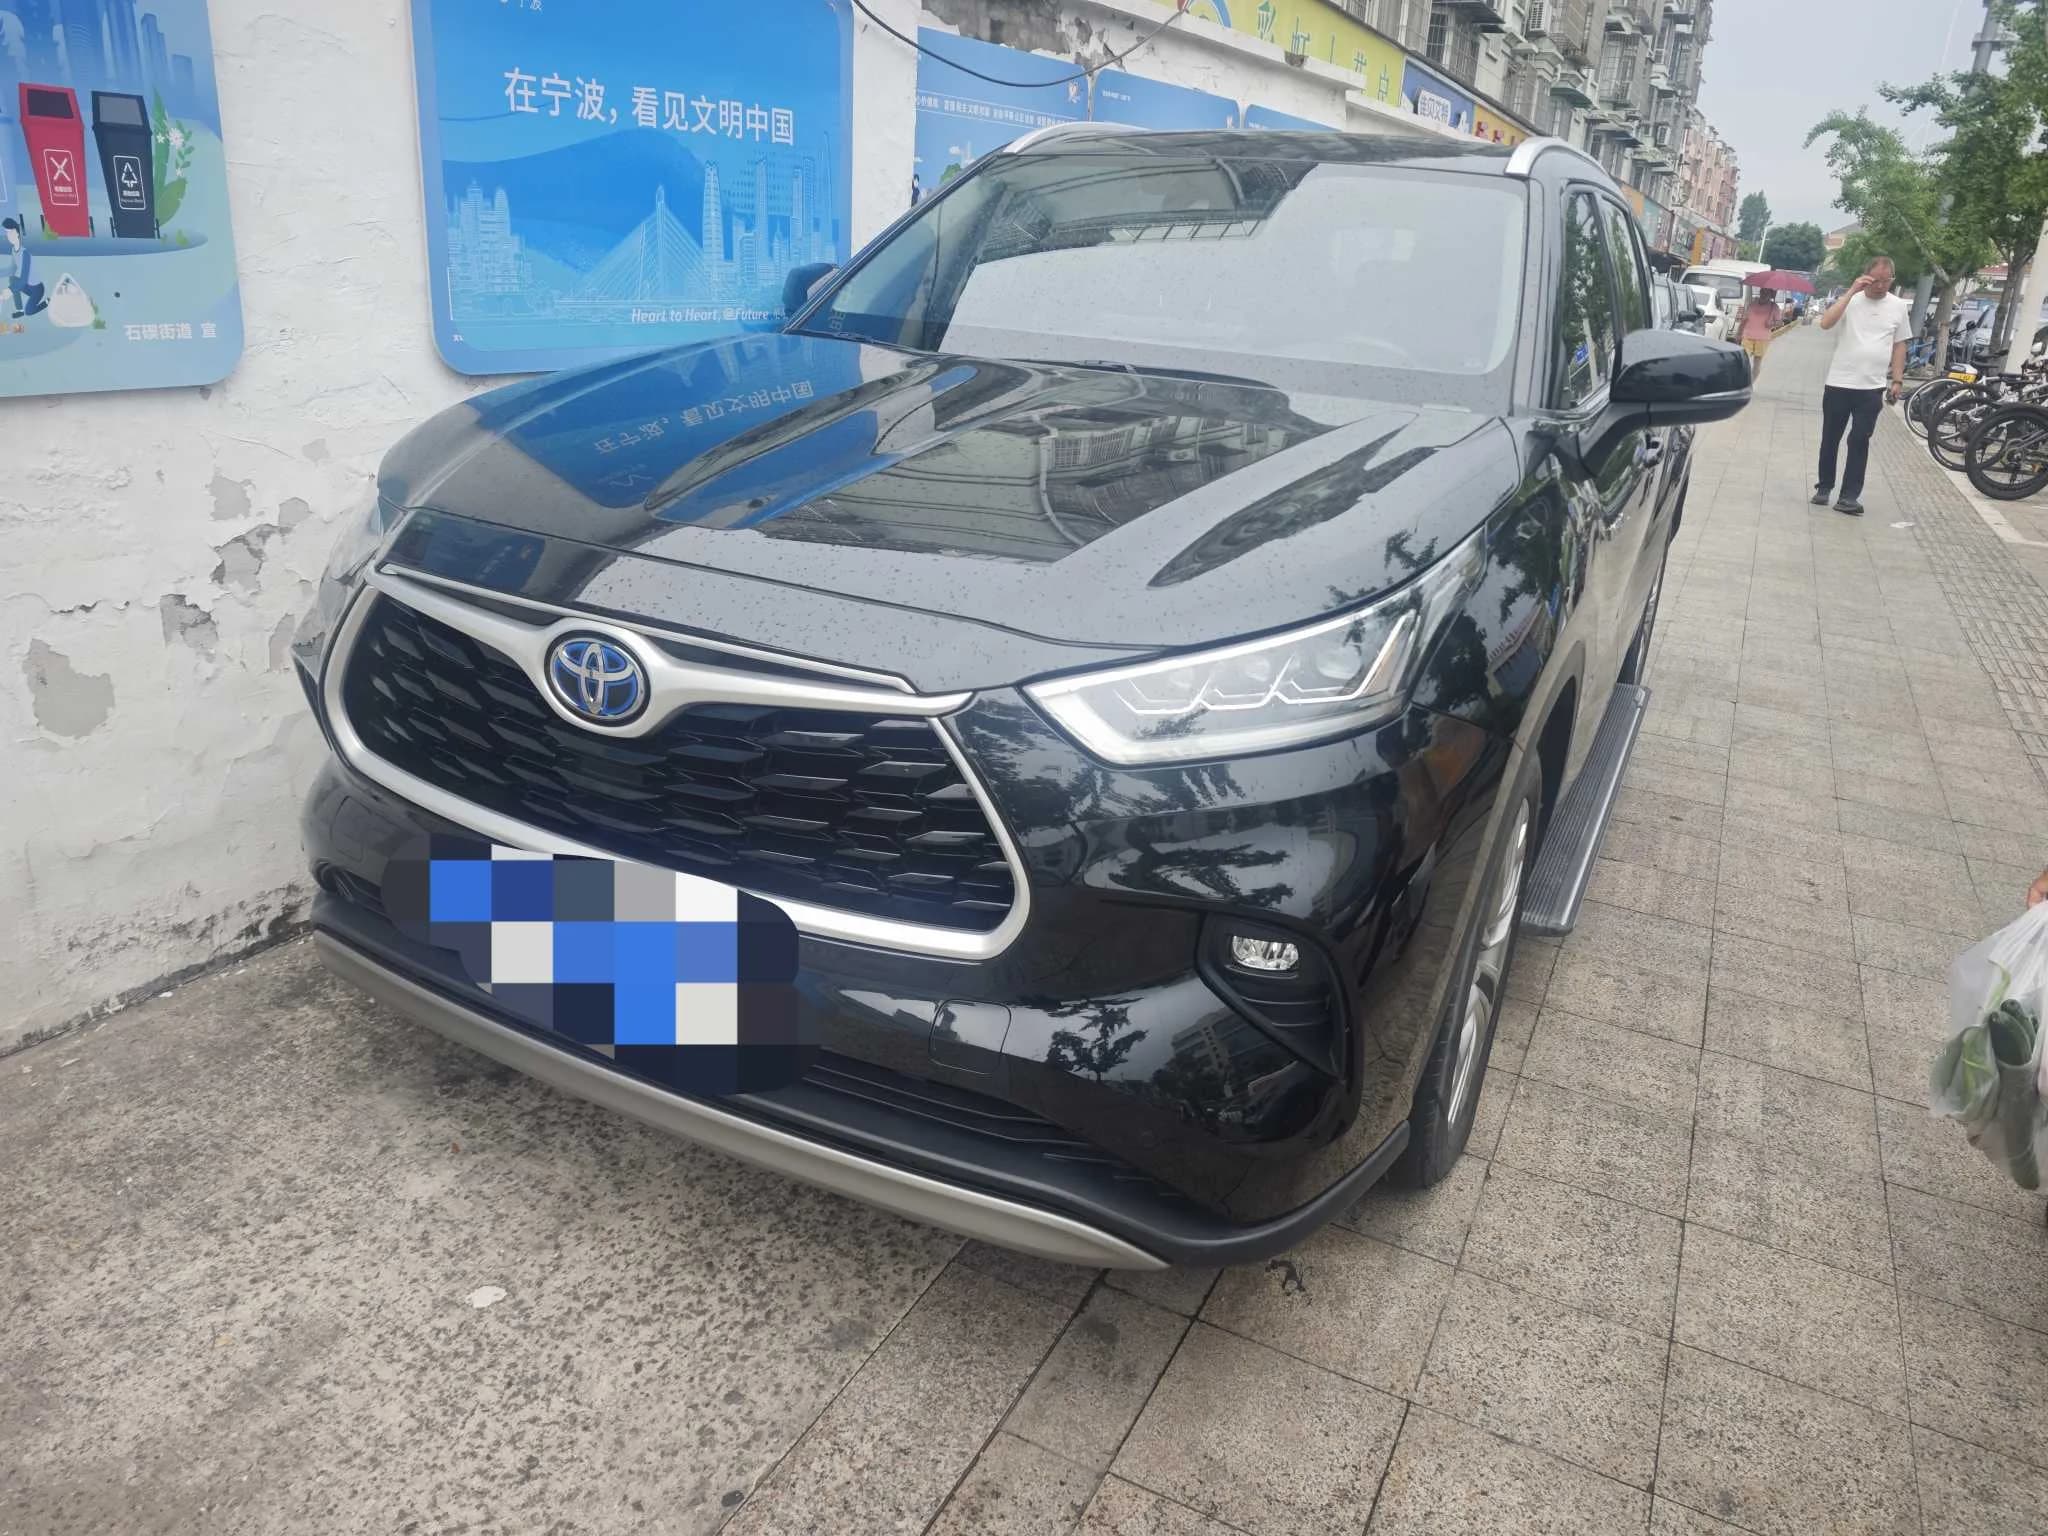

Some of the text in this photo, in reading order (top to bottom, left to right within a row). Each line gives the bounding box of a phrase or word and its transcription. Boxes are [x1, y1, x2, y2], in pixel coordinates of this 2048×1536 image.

[503, 67, 794, 146] 在宁波，看见文明中国
[631, 307, 667, 323] Heart
[670, 308, 682, 322] to
